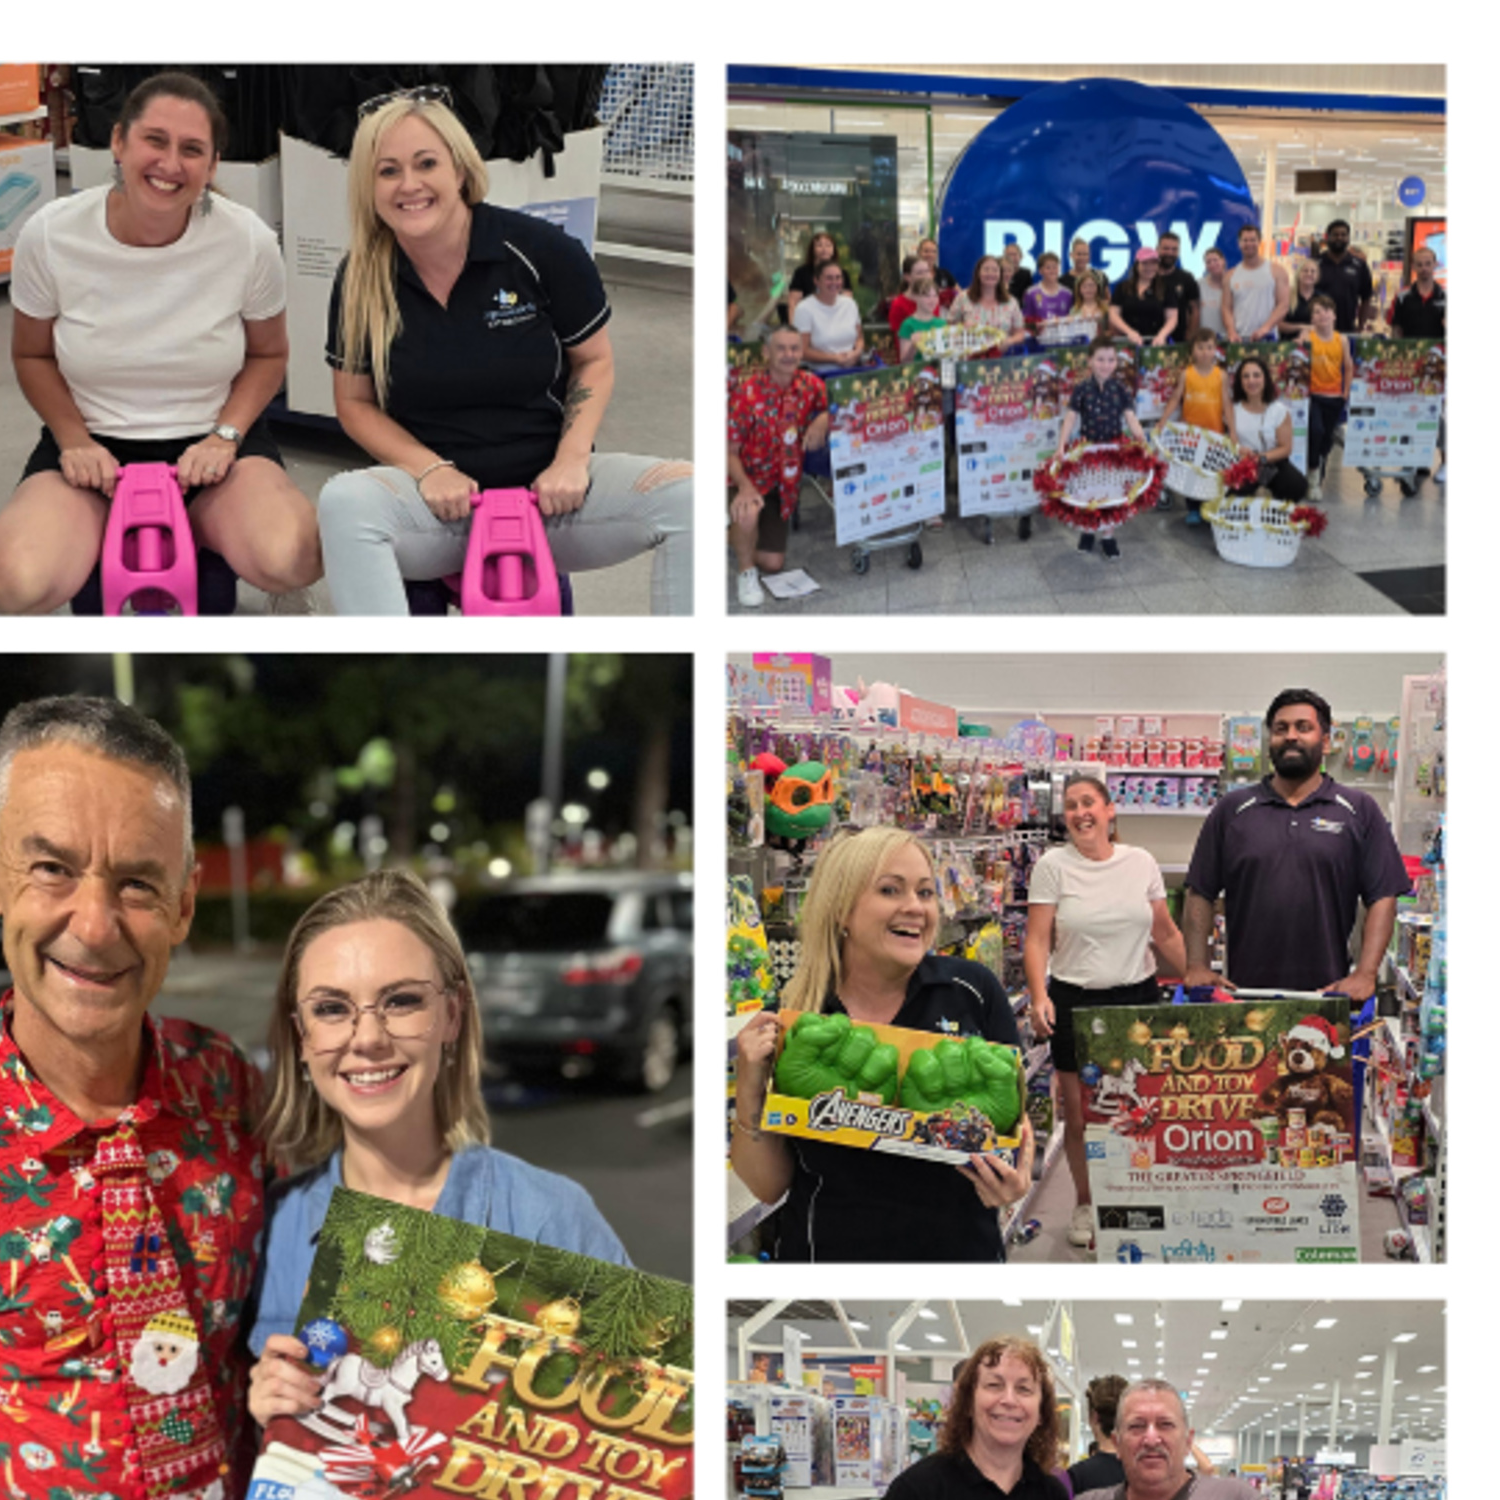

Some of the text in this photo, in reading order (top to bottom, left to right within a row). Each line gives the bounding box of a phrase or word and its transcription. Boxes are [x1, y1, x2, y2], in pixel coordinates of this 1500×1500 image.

[1149, 1035, 1265, 1073] FOOD
[1160, 1074, 1257, 1093] AND TOY
[807, 1086, 912, 1136] AVENGERS
[1163, 1123, 1254, 1152] Orion
[455, 1400, 687, 1491] AND TOY
